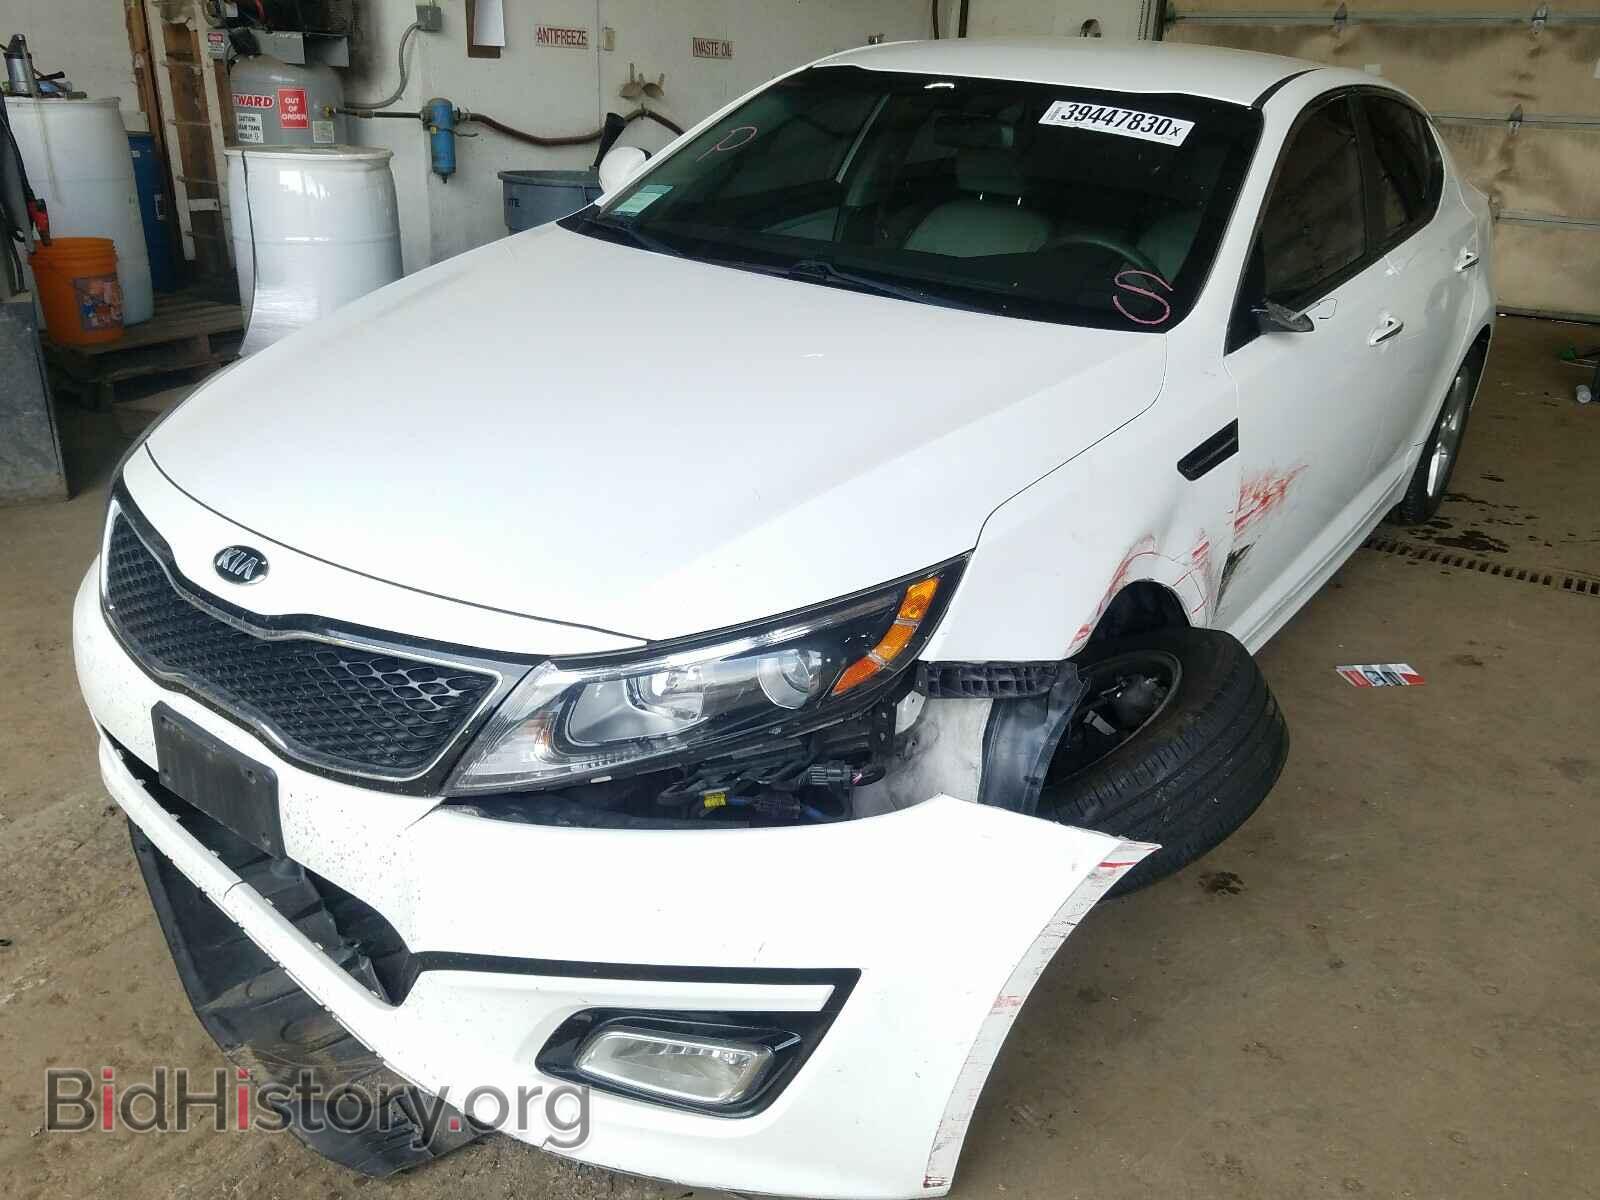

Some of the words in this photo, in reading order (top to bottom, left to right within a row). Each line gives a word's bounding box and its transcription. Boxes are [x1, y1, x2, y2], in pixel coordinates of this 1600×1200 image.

[537, 27, 587, 46] ANTIFREEZE
[694, 39, 719, 57] WASTE
[721, 40, 732, 57] OIL
[281, 113, 308, 121] ORDER
[216, 547, 259, 580] KIA
